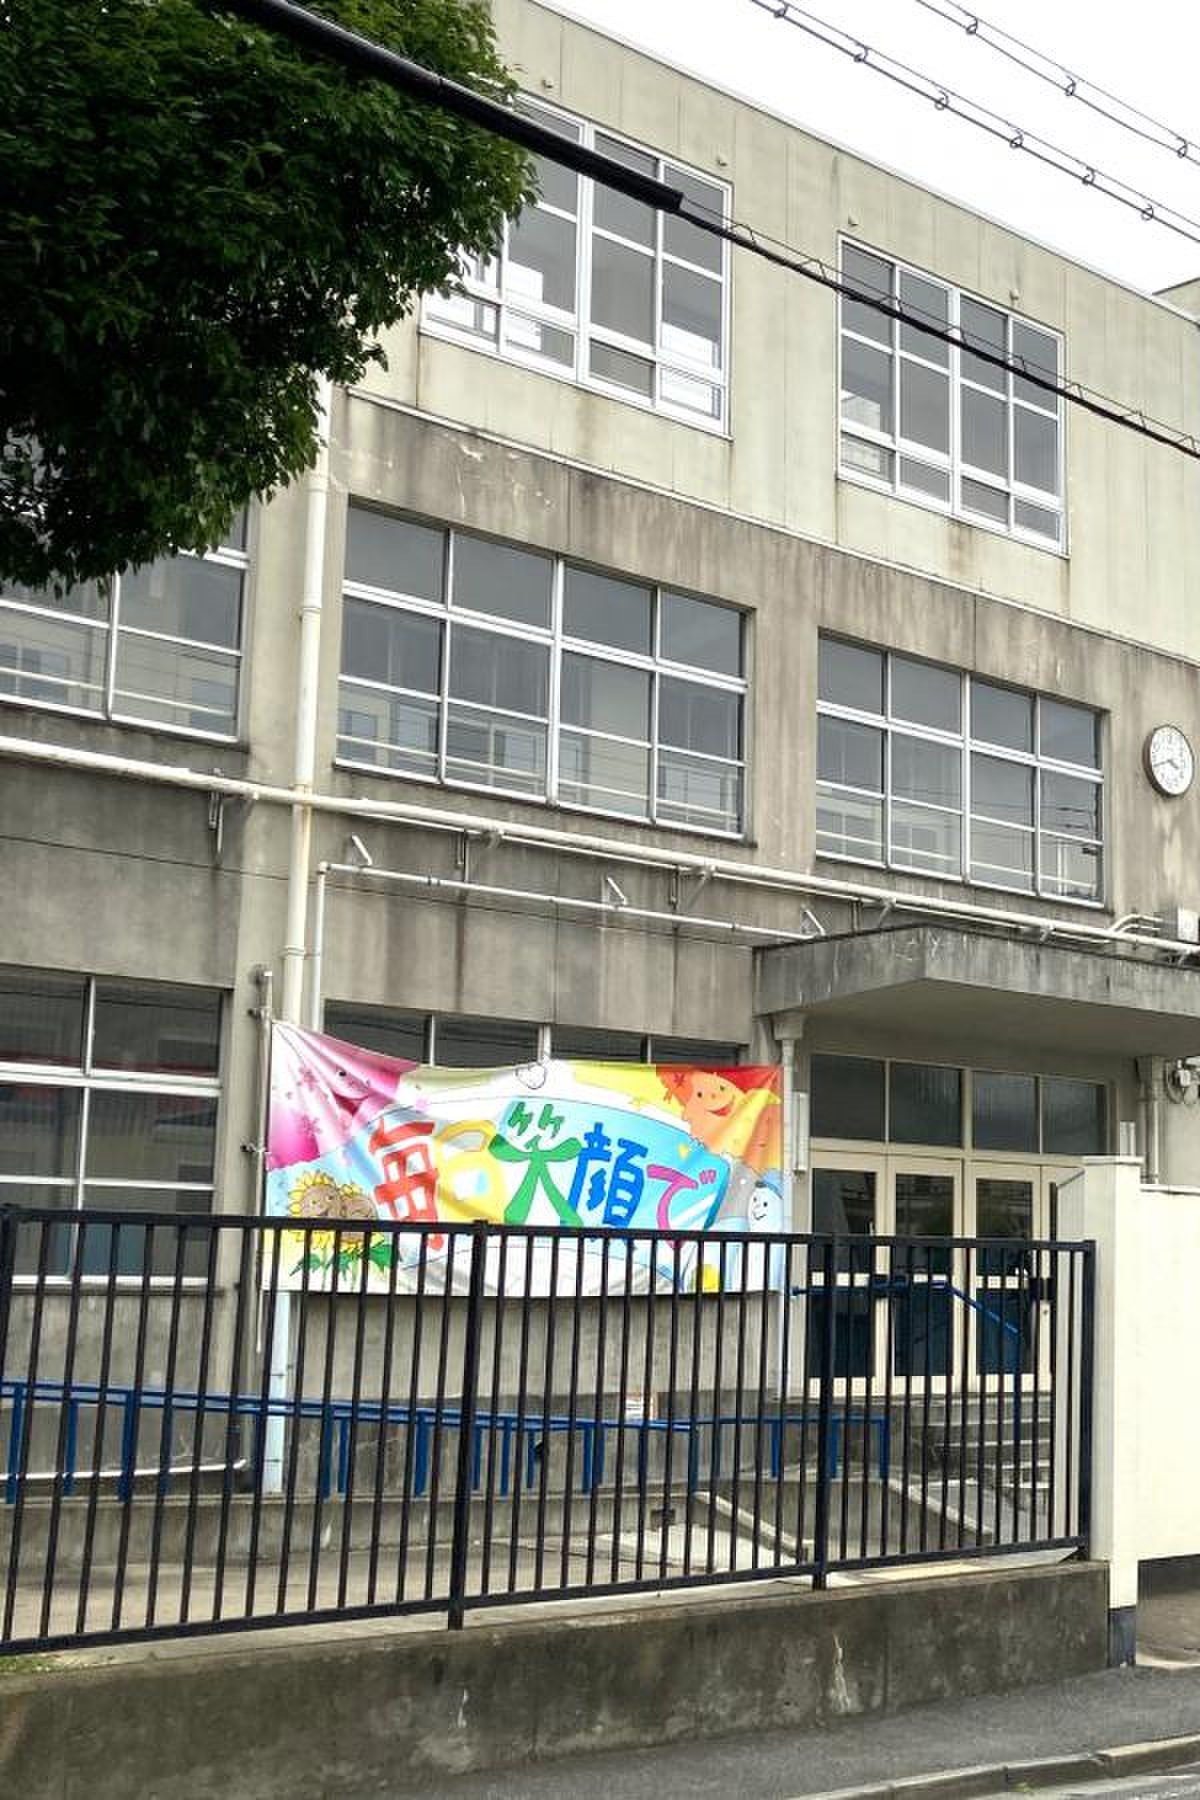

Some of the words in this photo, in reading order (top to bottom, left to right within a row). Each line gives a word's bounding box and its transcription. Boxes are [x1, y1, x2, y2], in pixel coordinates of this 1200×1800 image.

[368, 1101, 717, 1249] 毎日笑顔で
